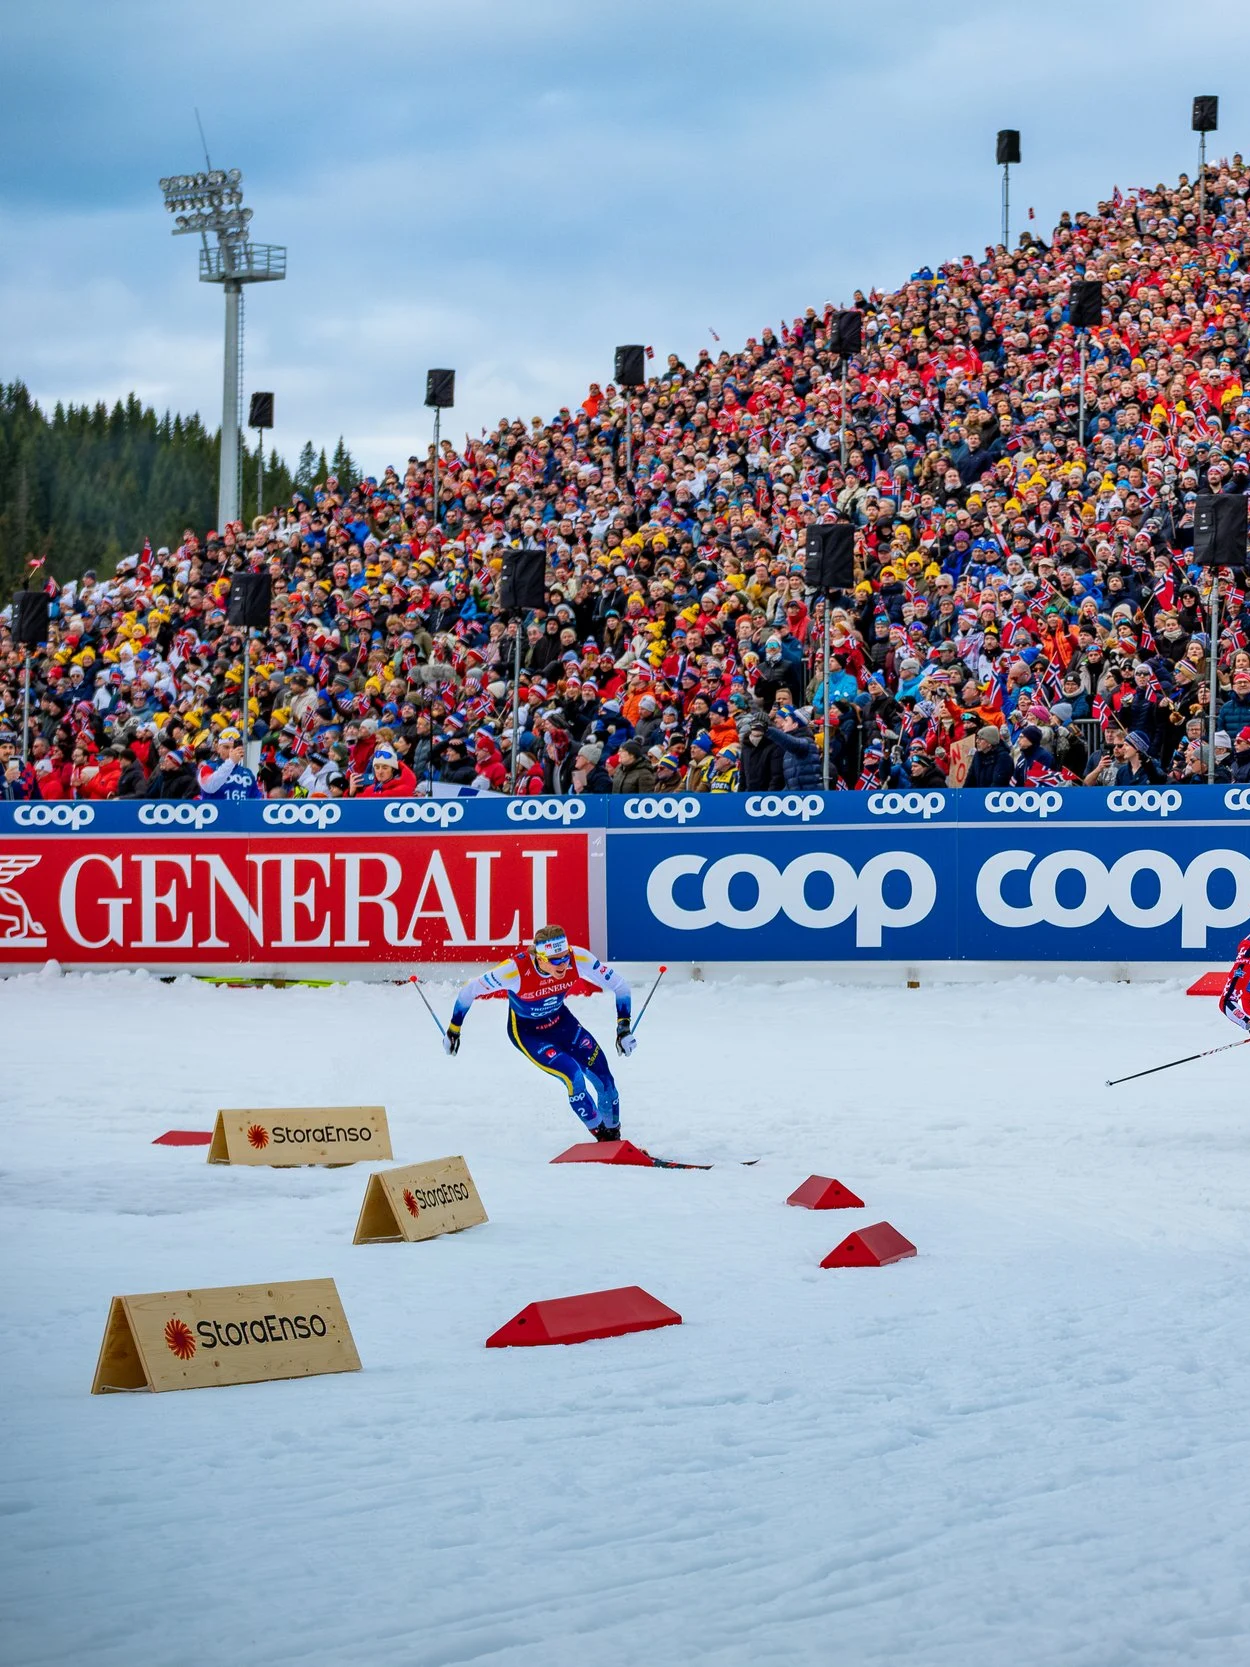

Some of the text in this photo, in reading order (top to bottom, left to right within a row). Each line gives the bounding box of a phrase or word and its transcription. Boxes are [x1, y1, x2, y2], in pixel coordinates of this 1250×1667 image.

[384, 802, 463, 827] coop
[507, 799, 585, 824] coop
[624, 798, 700, 823] coop
[745, 795, 824, 821] coop
[868, 792, 945, 818] coop
[985, 791, 1062, 817] coop
[1107, 790, 1182, 816] coop
[14, 805, 94, 830] coop
[139, 804, 218, 829] coop
[263, 804, 341, 828] coop
[59, 849, 558, 949] GENERALI
[647, 852, 936, 947] coop
[577, 1107, 588, 1117] 2
[271, 1126, 372, 1144] StoraEnso
[414, 1181, 470, 1210] StoraEnso
[196, 1314, 327, 1349] StoraEnso
